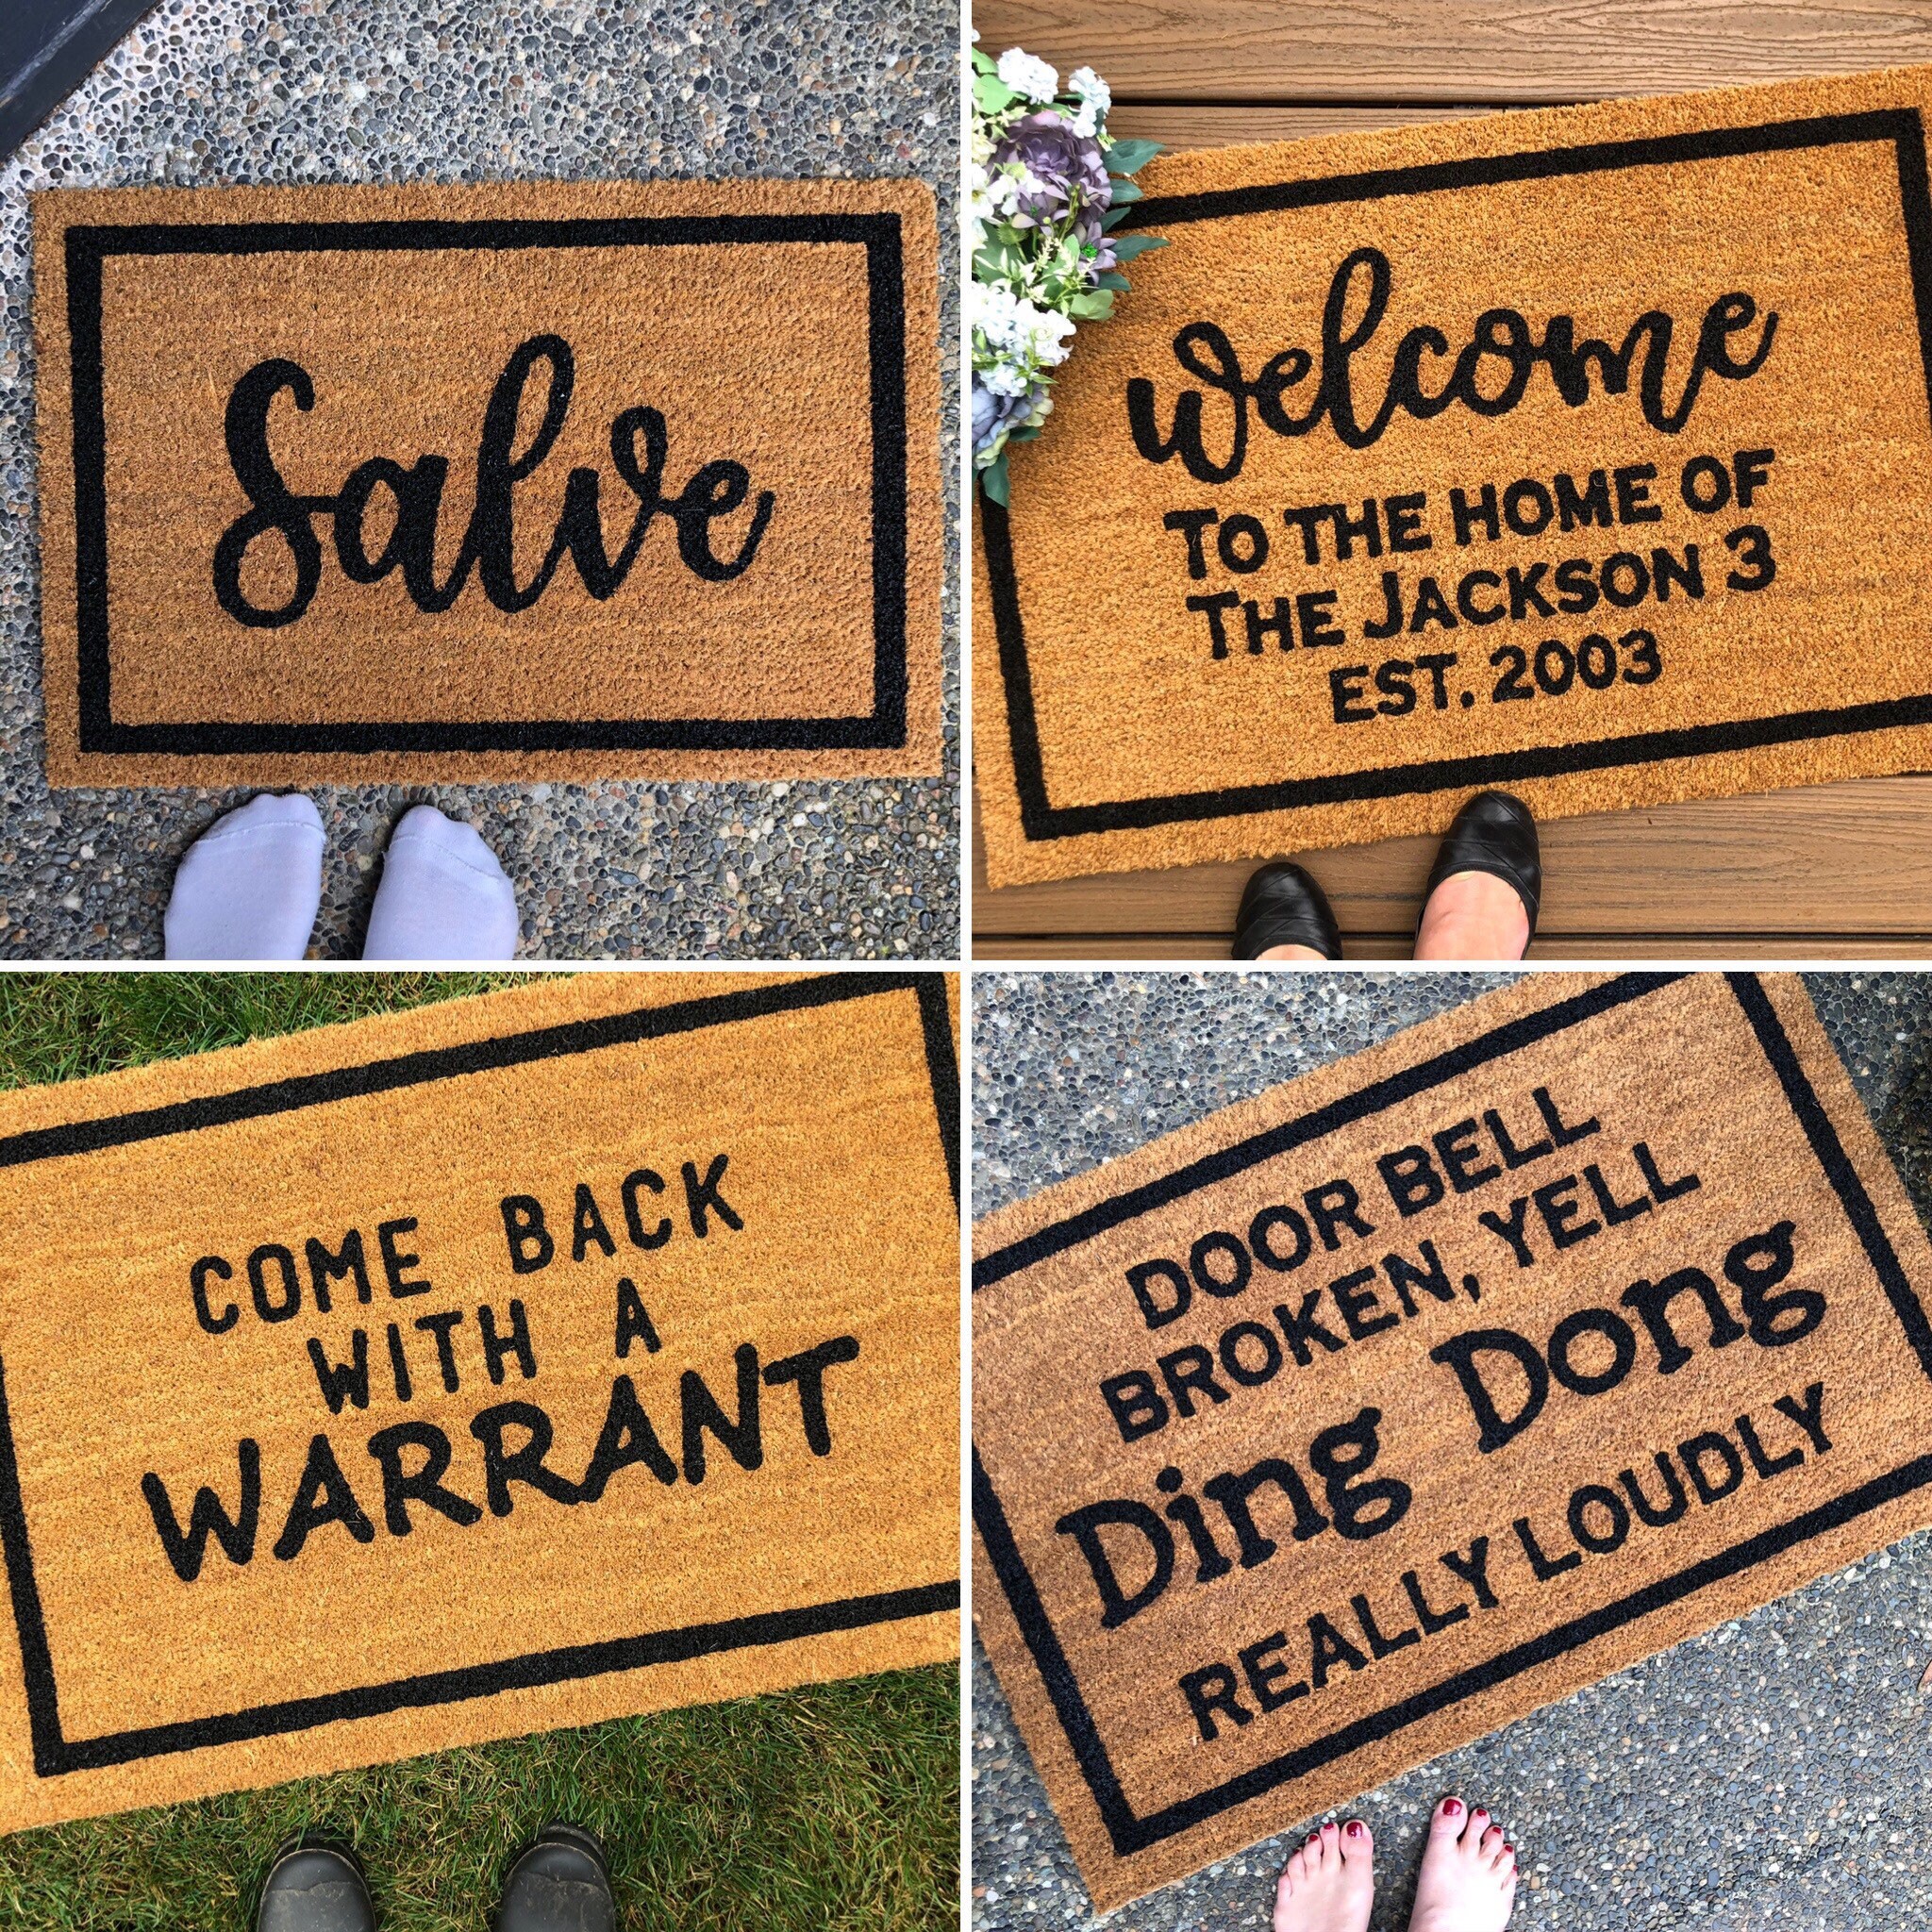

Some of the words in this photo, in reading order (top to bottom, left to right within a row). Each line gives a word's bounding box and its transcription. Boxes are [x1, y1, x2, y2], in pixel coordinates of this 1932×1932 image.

[211, 334, 775, 629] Salve
[1127, 247, 1778, 484] welcome
[1163, 508, 1269, 580] TO
[1284, 492, 1432, 564] THE
[1450, 464, 1662, 545] HOME
[1681, 449, 1774, 513] OF
[1187, 591, 1345, 659] THE
[1364, 544, 1705, 639] JACKSON
[1724, 525, 1776, 591] 3
[1491, 629, 1662, 702] 2003
[191, 1217, 431, 1334] COME
[501, 1155, 743, 1274] BACK
[1100, 1241, 1480, 1442] BROKEN,
[1479, 1143, 1701, 1267] YELL
[1126, 1179, 1374, 1329] DOOR
[1377, 1088, 1600, 1218] BELL
[142, 1336, 859, 1581] WARRANT
[308, 1300, 536, 1413] WITH
[616, 1278, 661, 1357] A
[1055, 1407, 1411, 1629] Ding
[1430, 1221, 1826, 1454] Dong
[1178, 1537, 1498, 1741] REALLY
[1513, 1382, 1832, 1581] LOUDLY
